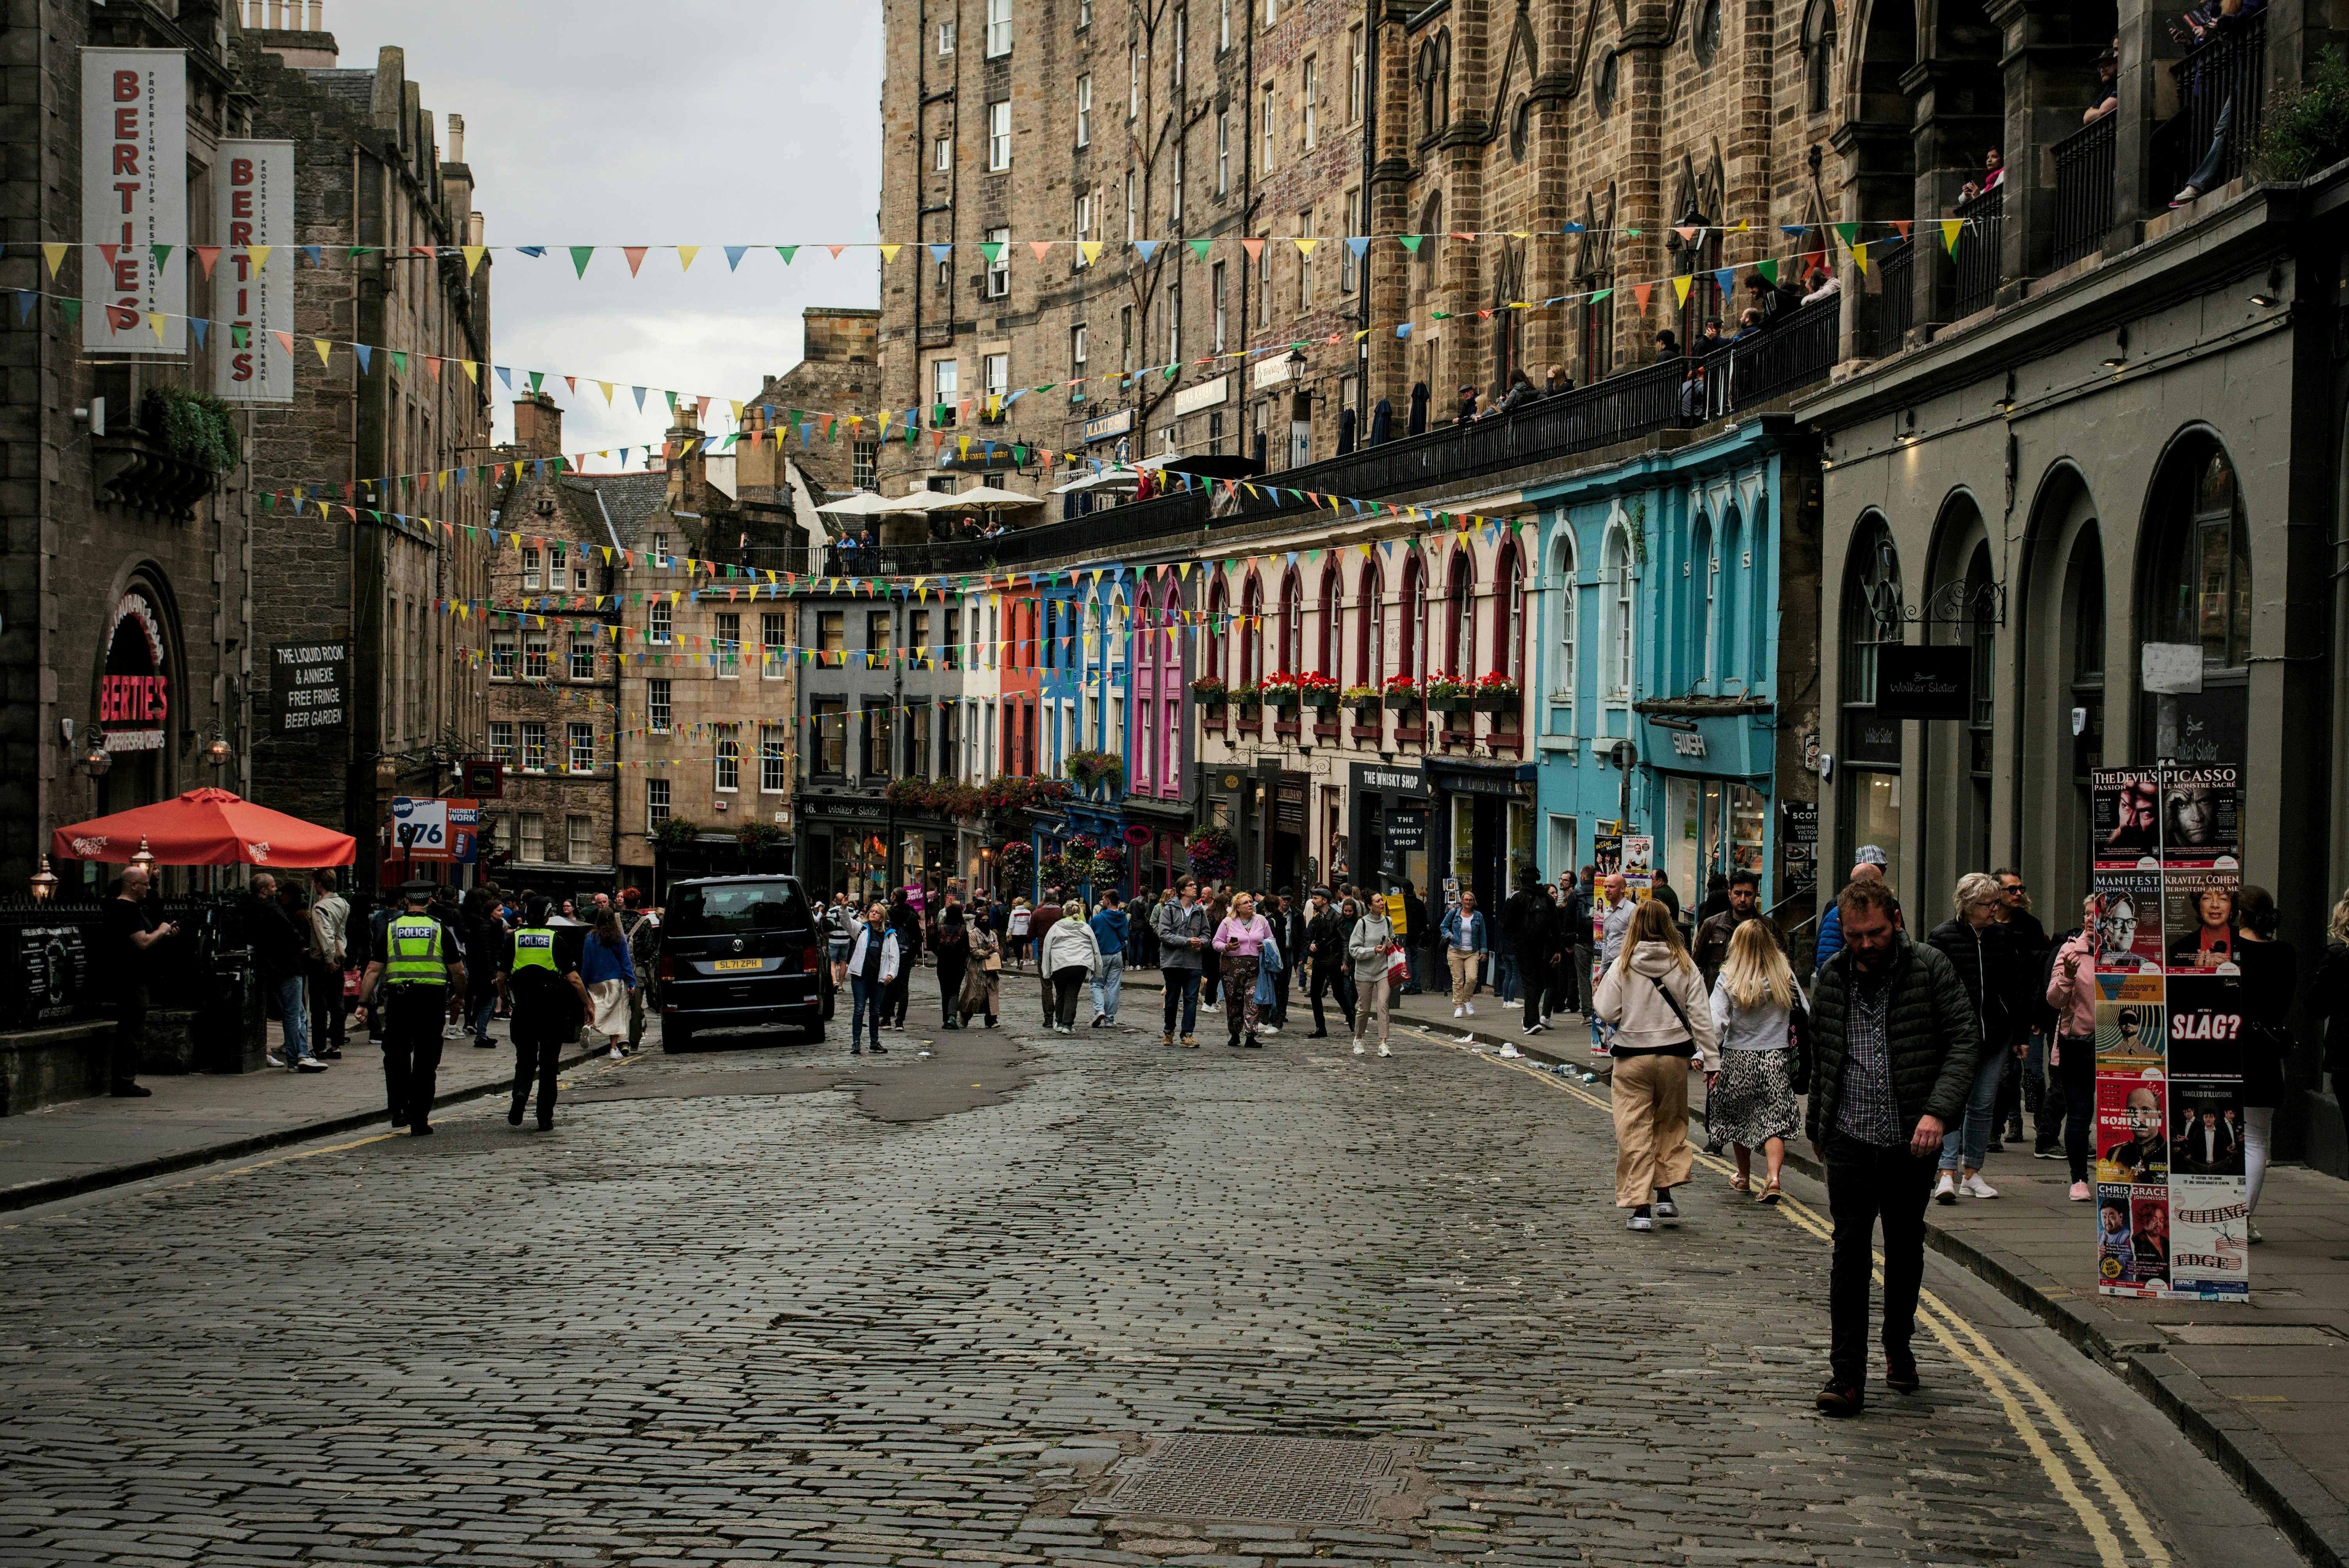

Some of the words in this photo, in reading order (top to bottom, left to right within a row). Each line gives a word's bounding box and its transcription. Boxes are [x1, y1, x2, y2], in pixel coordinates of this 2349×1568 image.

[113, 70, 141, 330] BERTIES
[231, 159, 253, 381] BERTIES
[277, 649, 295, 664] THE
[294, 647, 322, 663] LIQUID
[321, 645, 344, 661] ROOM
[296, 670, 302, 684] &
[303, 667, 334, 684] ANNEXE
[1891, 682, 1926, 693] Walker
[1928, 682, 1957, 693] Slater
[100, 675, 168, 721] BERTIE'S
[289, 690, 312, 706] FREE
[313, 688, 340, 704] FRINGE
[285, 712, 309, 729] BEER
[311, 709, 342, 726] GARDEN
[1865, 727, 1880, 743] Walker
[1880, 727, 1893, 743] Slater
[1672, 732, 1706, 756] SWISH
[2177, 737, 2195, 761] alker
[2196, 738, 2219, 761] Slater
[1364, 771, 1376, 785] THE
[1377, 772, 1400, 787] WHISKY
[1401, 774, 1418, 789] SHOP
[2093, 773, 2116, 784] THE
[2117, 769, 2158, 784] DEVIL'S
[2164, 769, 2236, 782] PICASSO
[393, 803, 412, 812] fringe
[803, 803, 816, 814] 46.
[828, 805, 854, 815] Walker
[858, 805, 880, 816] Slater
[72, 836, 108, 850] APEROL
[77, 845, 102, 856] SPRITZ
[249, 841, 270, 856] APEROL
[1596, 840, 1612, 850] INSANE
[2096, 876, 2160, 886] MANIFEST
[2165, 876, 2204, 886] KRAVITZ,
[2206, 875, 2239, 884] COHEN
[398, 928, 430, 937] POLICE
[519, 936, 549, 946] POLICE
[720, 960, 739, 969] SL71
[740, 959, 757, 968] ZPH
[2171, 1014, 2241, 1039] SLAG?
[2098, 1185, 2128, 1194] CHRIS
[2132, 1187, 2167, 1196] GRACE
[2179, 1204, 2248, 1223] CUTTING
[2177, 1254, 2228, 1269] EDGE
